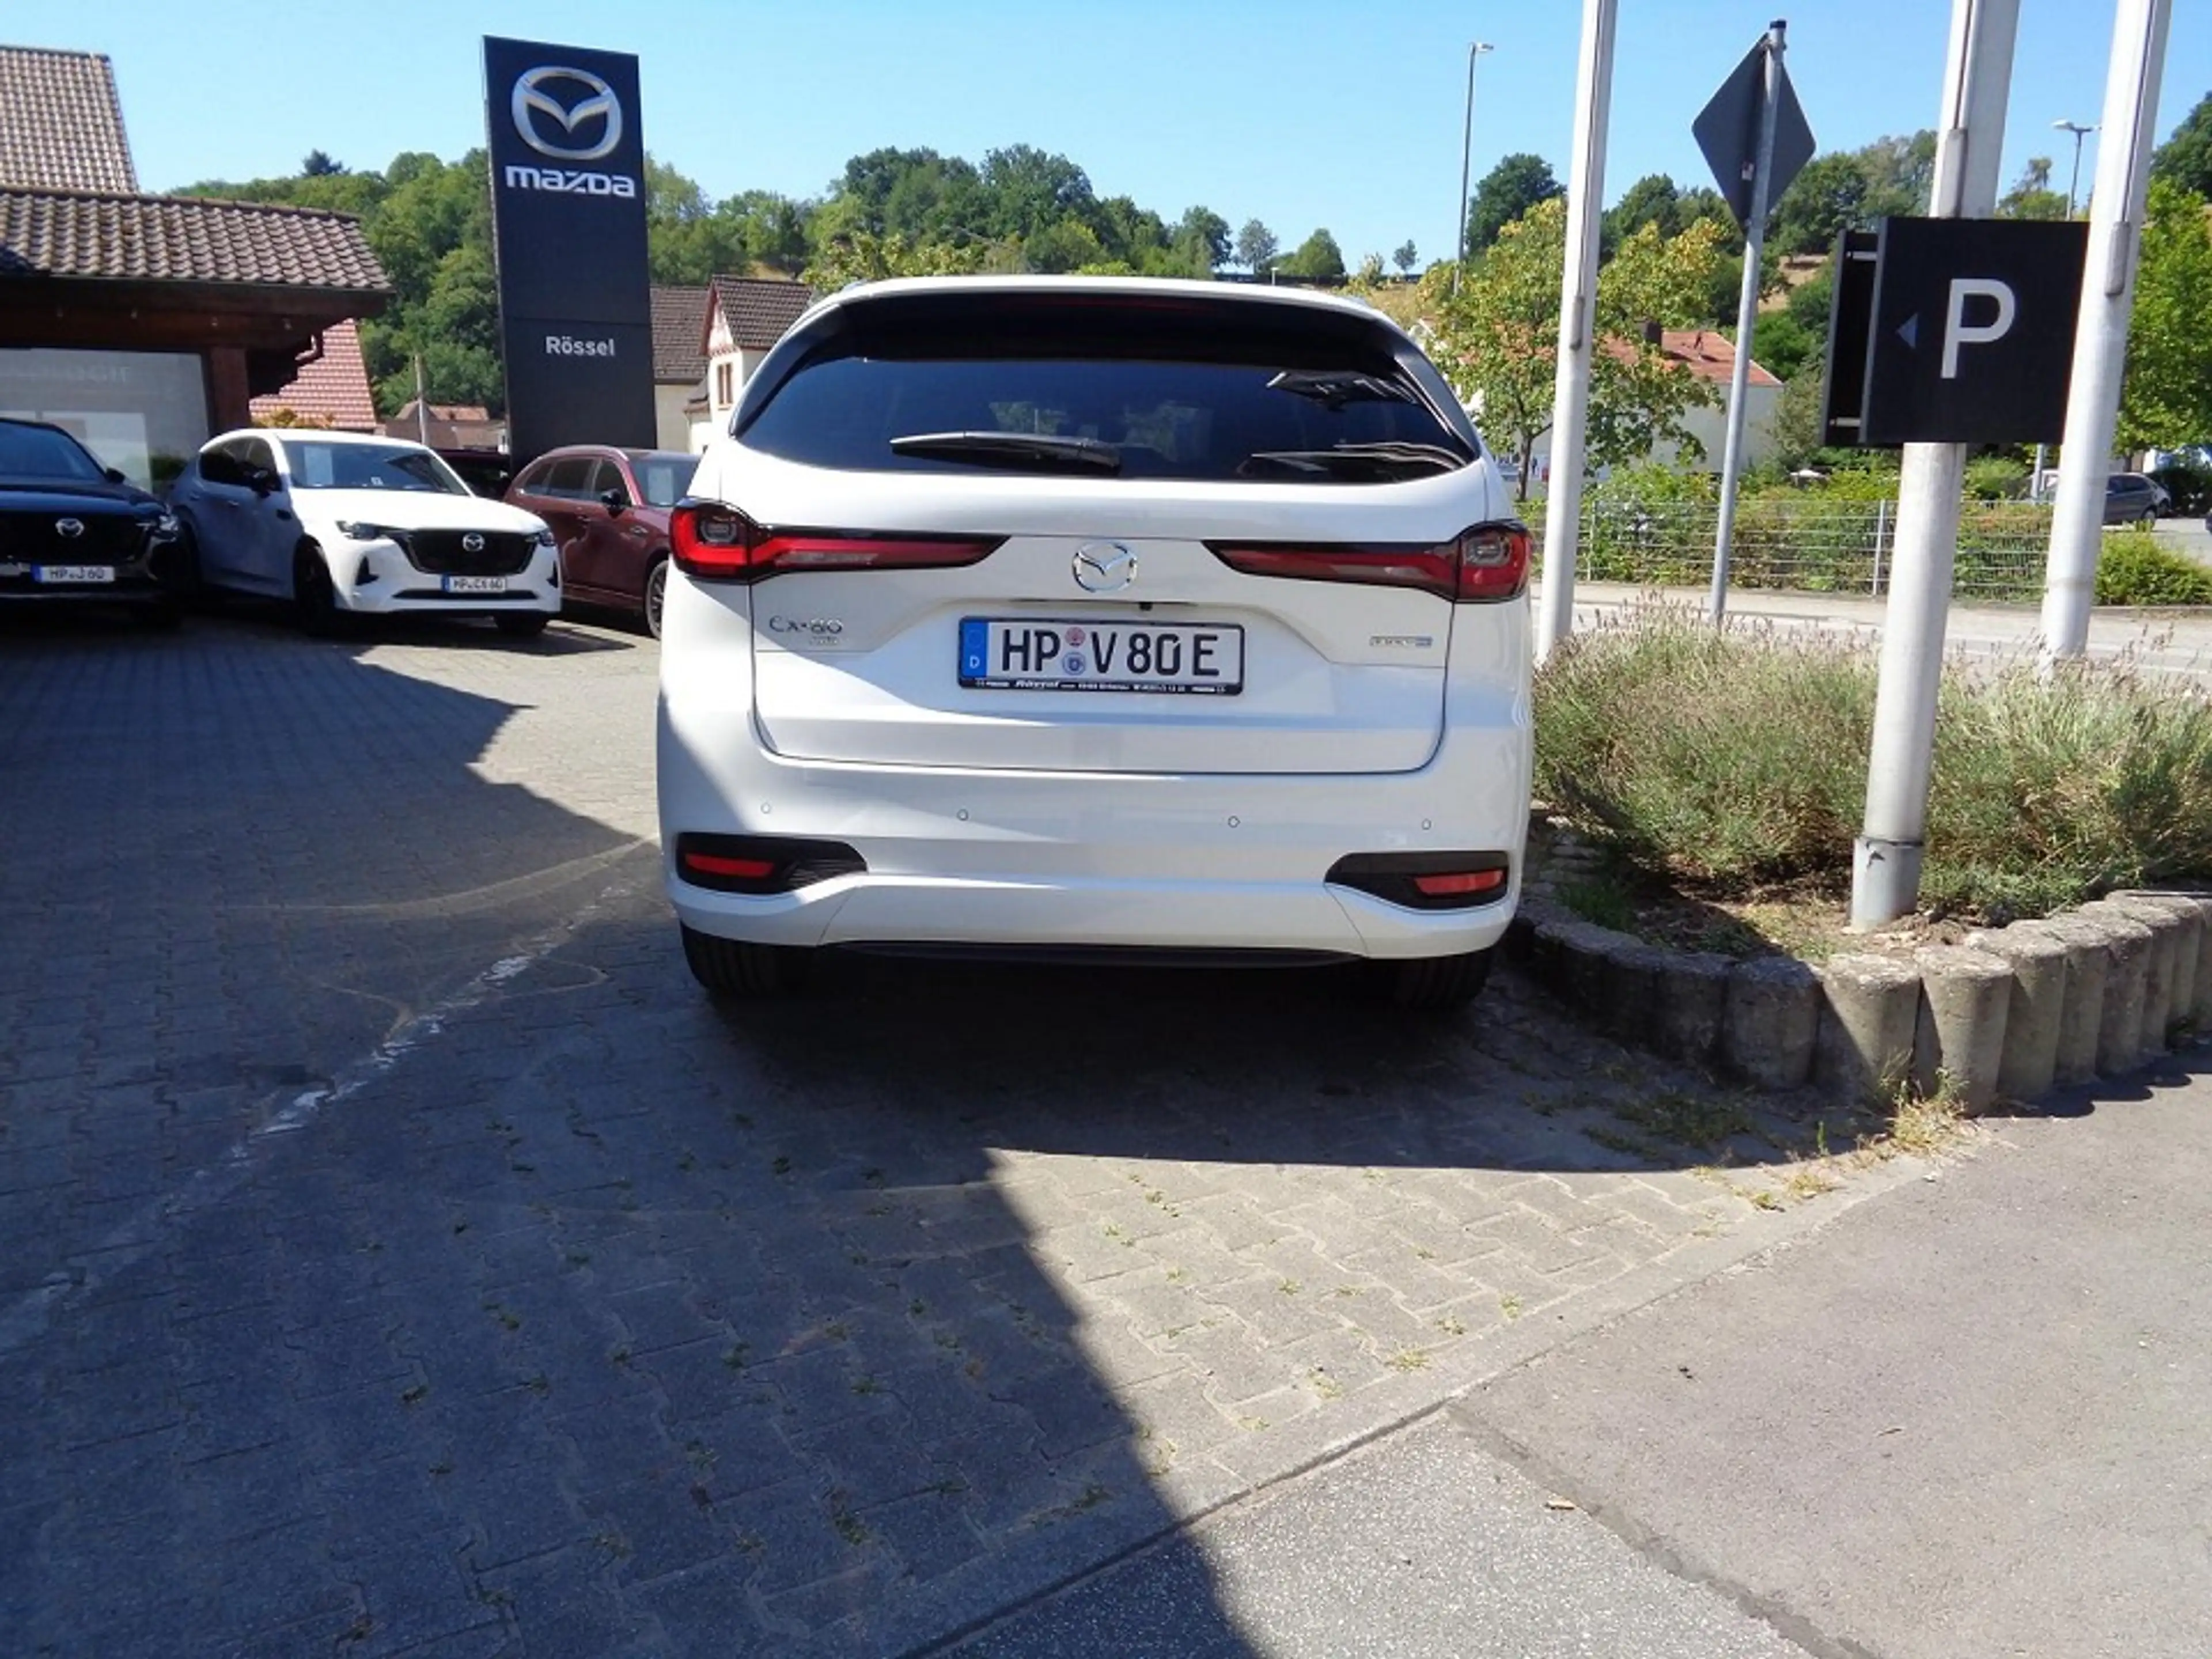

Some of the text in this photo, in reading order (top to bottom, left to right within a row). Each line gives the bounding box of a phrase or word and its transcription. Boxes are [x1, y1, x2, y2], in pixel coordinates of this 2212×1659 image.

[505, 166, 635, 198] mazda
[545, 336, 616, 356] Rössel
[1941, 279, 2015, 378] P
[1001, 629, 1061, 672] HP
